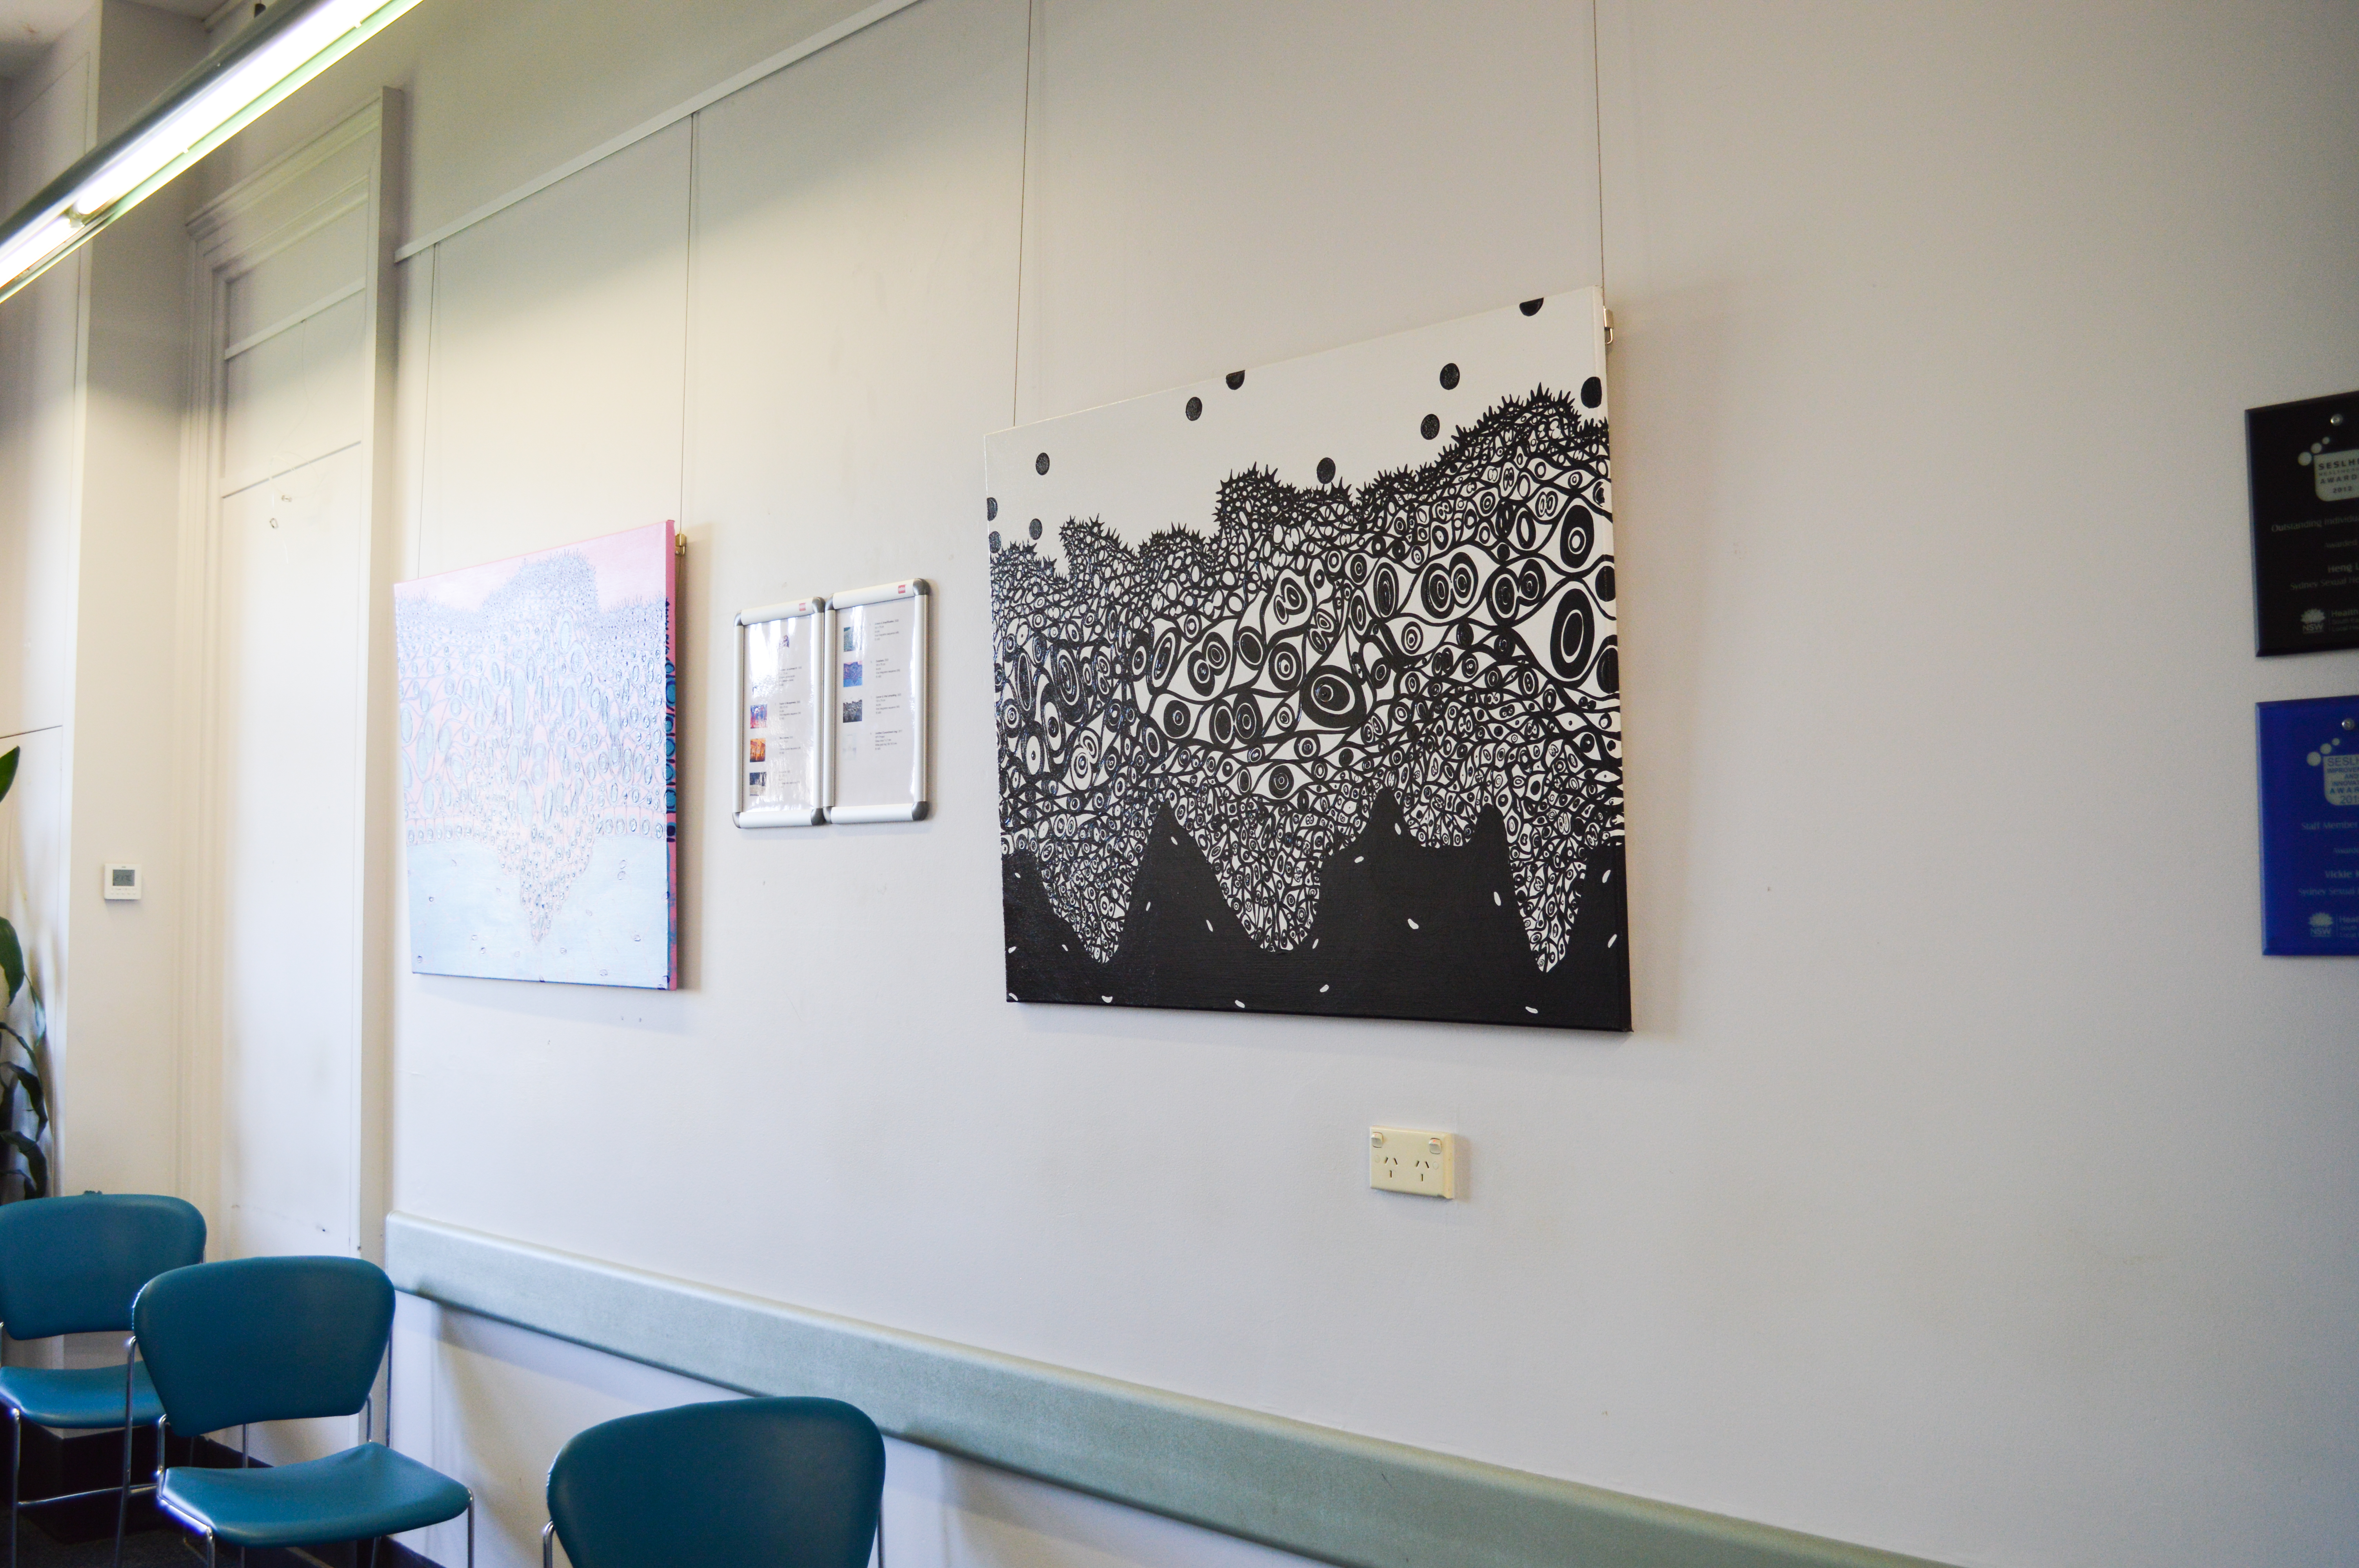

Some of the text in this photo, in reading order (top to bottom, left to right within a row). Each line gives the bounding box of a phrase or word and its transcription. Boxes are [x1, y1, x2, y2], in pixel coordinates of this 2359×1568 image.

[2271, 519, 2322, 532] Outstanding
[2327, 563, 2352, 573] Heng
[2290, 581, 2318, 590] Sydney
[2320, 577, 2346, 586] Sexual
[2303, 623, 2323, 631] NSW
[2340, 795, 2359, 804] 201
[2301, 820, 2357, 830] Staff Member
[2298, 887, 2326, 897] Sydney
